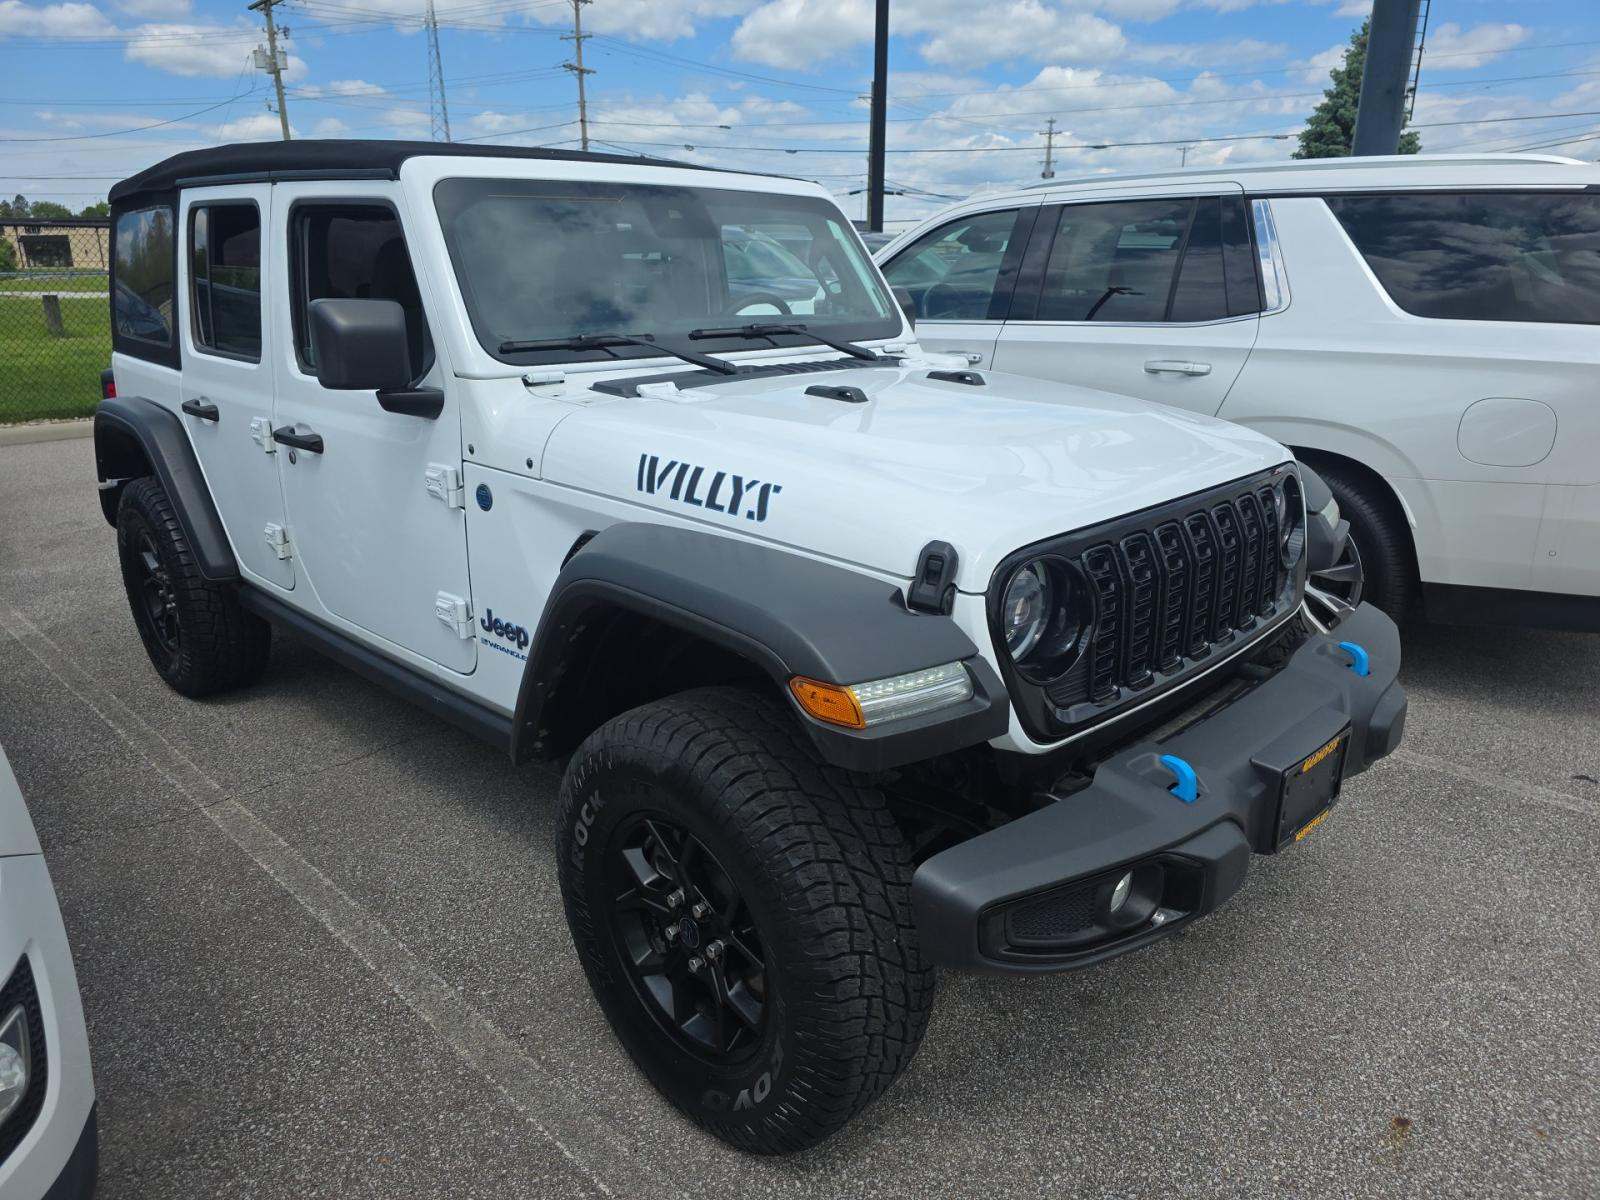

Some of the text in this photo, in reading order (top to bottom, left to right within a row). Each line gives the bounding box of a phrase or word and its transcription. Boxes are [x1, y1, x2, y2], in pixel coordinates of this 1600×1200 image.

[637, 453, 783, 522] WILLYS
[480, 607, 529, 650] Jeep
[488, 640, 528, 662] WRANGLE
